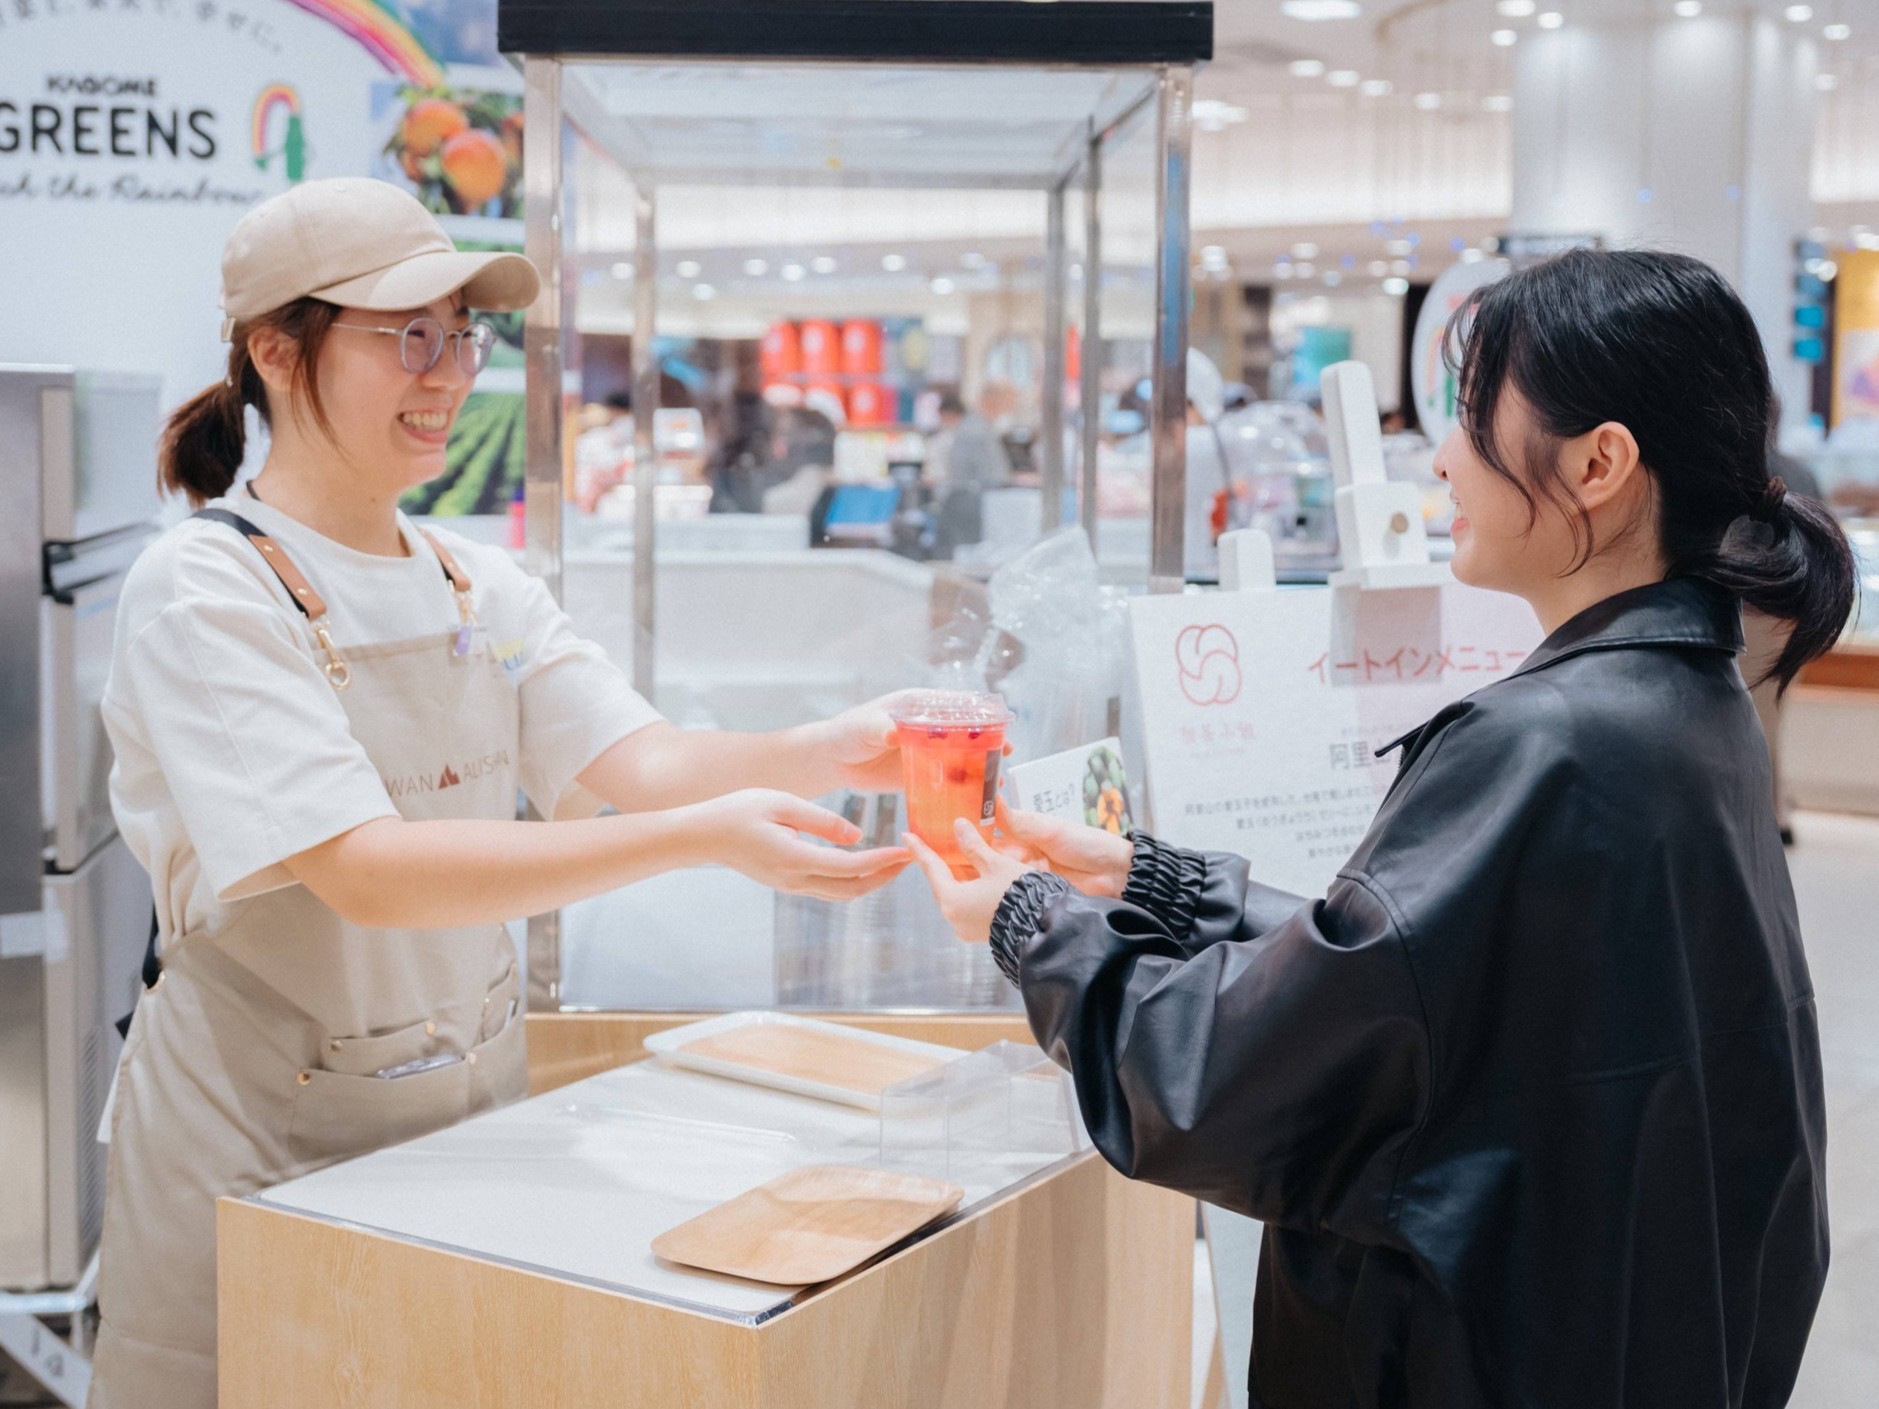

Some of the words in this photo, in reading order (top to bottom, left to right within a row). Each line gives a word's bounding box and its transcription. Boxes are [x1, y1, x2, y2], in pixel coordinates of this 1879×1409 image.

[1308, 645, 1528, 684] イートインメニュー
